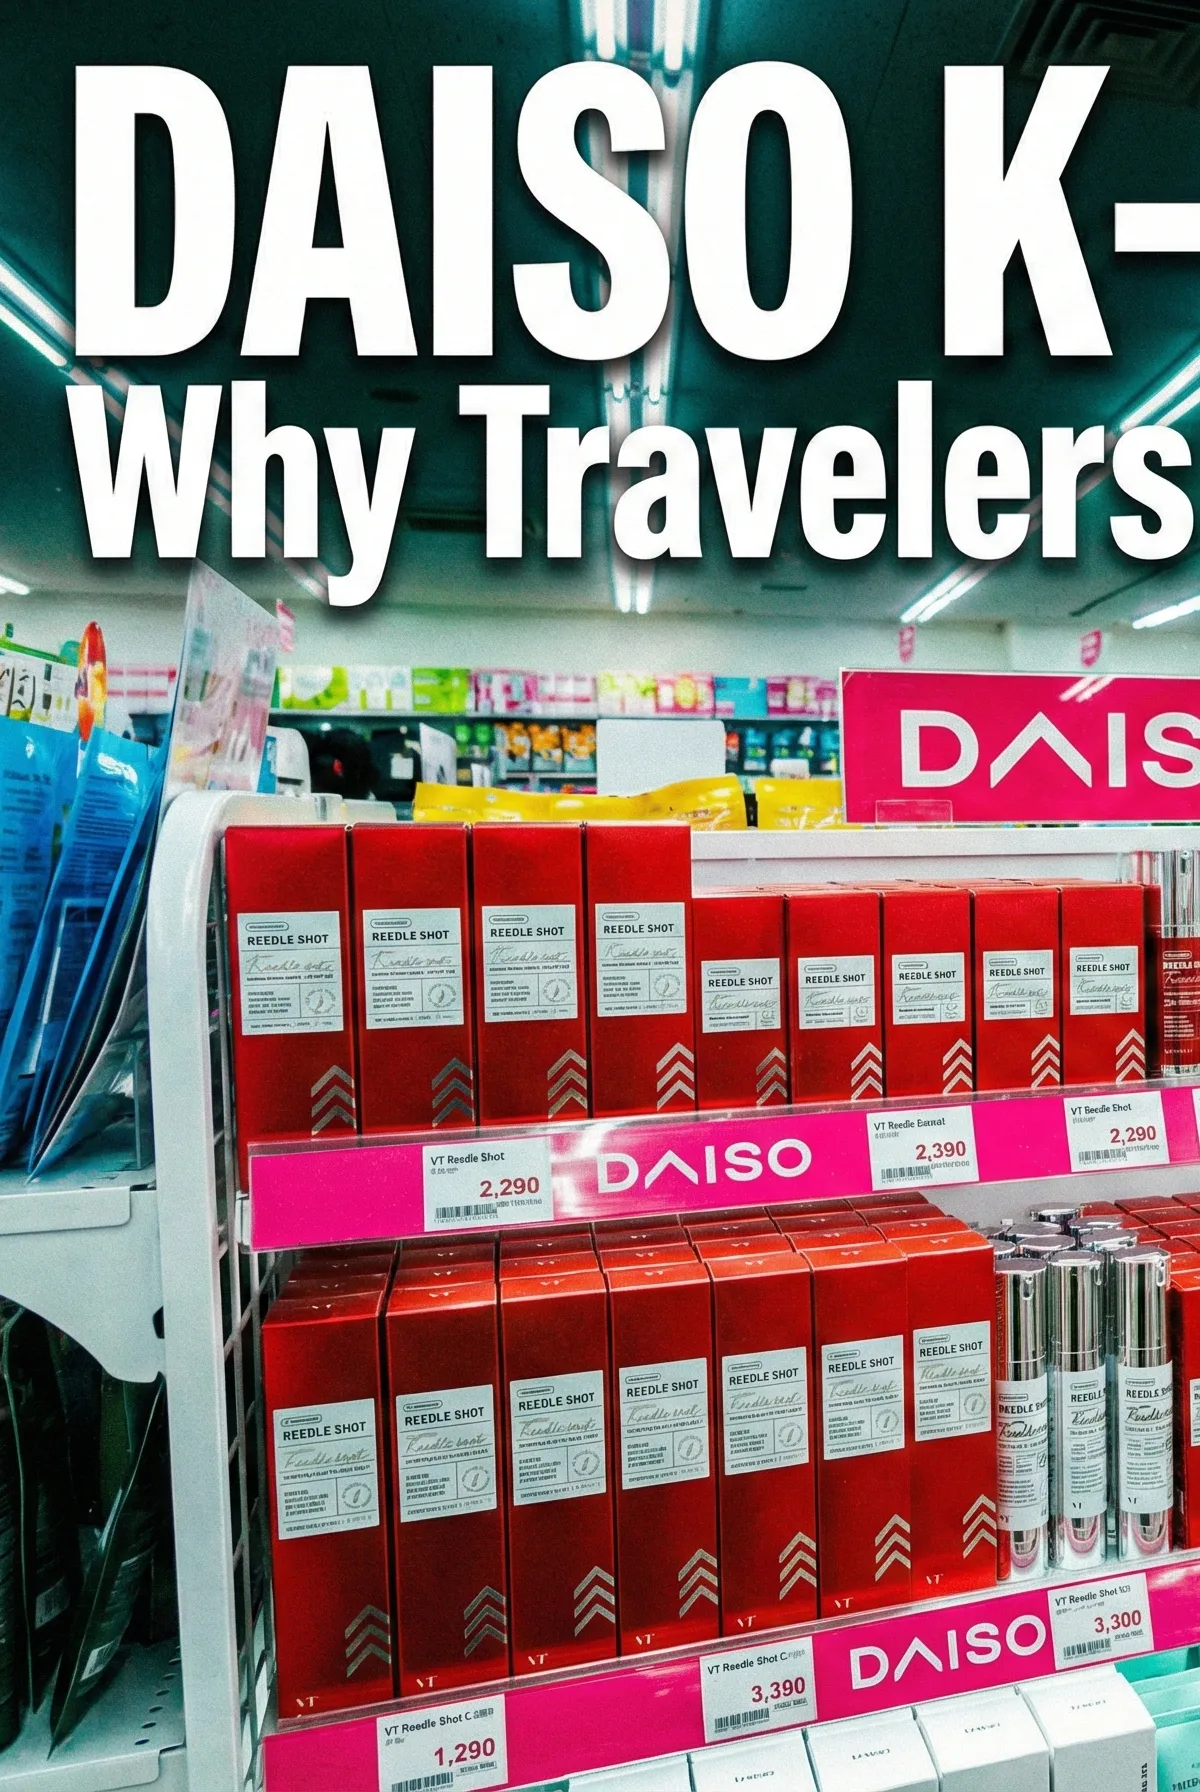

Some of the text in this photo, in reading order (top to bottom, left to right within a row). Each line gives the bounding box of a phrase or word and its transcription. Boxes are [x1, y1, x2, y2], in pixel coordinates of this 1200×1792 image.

[372, 930, 450, 941] REEDLE SHOT
[490, 926, 564, 938] REEDLE SHOT
[604, 924, 674, 934] REEDLE SHOT
[247, 934, 329, 946] REEDLE SHOT
[708, 976, 773, 988] REEDLE SHOT
[806, 973, 866, 984] REEDLE SHOT
[1070, 1107, 1082, 1116] VT
[874, 1122, 886, 1131] VT
[1110, 1125, 1156, 1146] 2,290
[430, 1156, 444, 1166] VT
[481, 1152, 505, 1162] Shot
[916, 1140, 966, 1162] 2,390
[598, 1138, 812, 1194] DAISO
[480, 1176, 540, 1199] 2,290
[919, 1341, 983, 1357] REEDLE SHOT
[828, 1356, 894, 1373] REEDLE SHOT
[729, 1368, 798, 1386] REEDLE SHOT
[626, 1380, 698, 1398] REEDLE SHOT
[518, 1392, 594, 1411] REEDLE SHOT
[404, 1406, 484, 1426] REEDLE SHOT
[283, 1422, 366, 1440] REEDLE SHOT
[1055, 1597, 1067, 1606] VT
[1100, 1588, 1118, 1598] Shot
[1094, 1610, 1142, 1634] 3,300
[850, 1614, 1046, 1690] DAISO
[708, 1665, 720, 1675] VT
[757, 1654, 778, 1666] Shot
[752, 1676, 806, 1704] 3,390
[384, 1726, 399, 1736] VT
[402, 1719, 436, 1734] Reedle
[440, 1714, 463, 1726] Shot
[434, 1738, 496, 1768] 1,290
